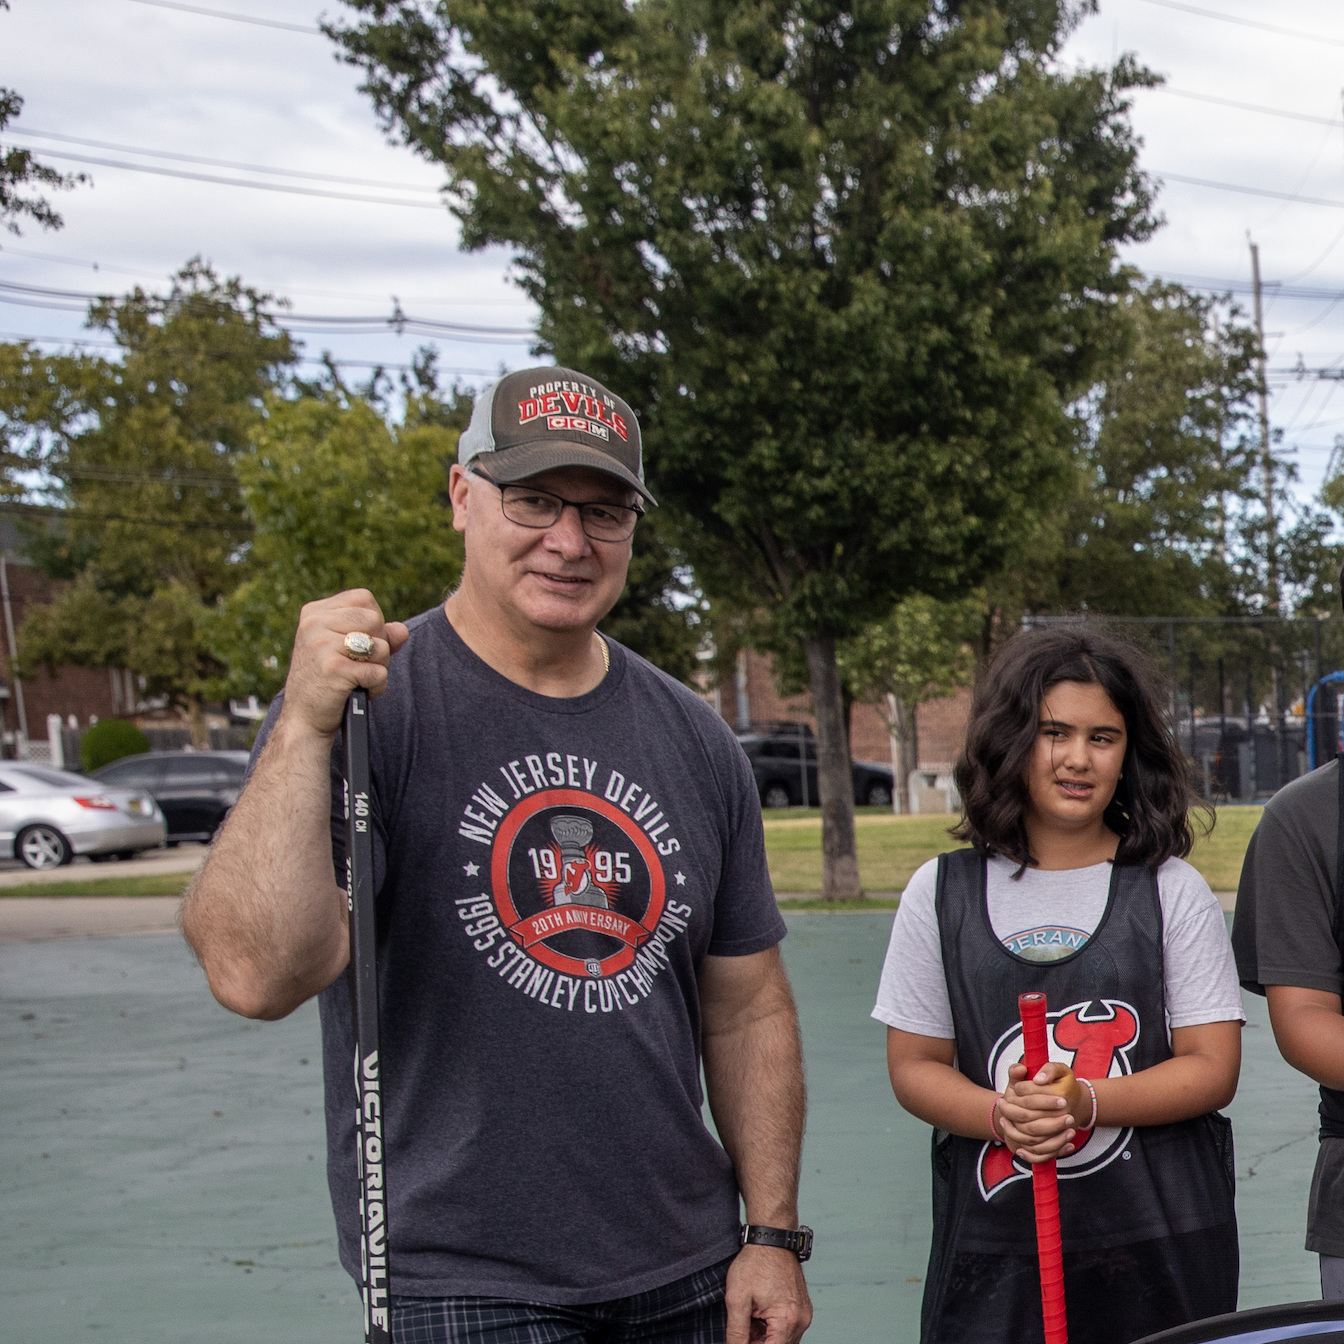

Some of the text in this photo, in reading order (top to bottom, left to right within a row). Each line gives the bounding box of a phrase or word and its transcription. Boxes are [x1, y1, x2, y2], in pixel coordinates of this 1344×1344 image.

[530, 381, 616, 410] PROPERTY OF
[518, 391, 628, 442] DEVILS
[548, 416, 609, 441] CCM
[355, 792, 368, 817] 140
[458, 752, 681, 856] NEW JERSEY DEVILS
[528, 848, 632, 883] 19 95
[532, 914, 564, 935] 20TH
[455, 892, 506, 951] 1995
[487, 941, 581, 1012] STANLEY
[584, 979, 623, 1014] CUP
[362, 1050, 388, 1333] VICTORIAVILLE
